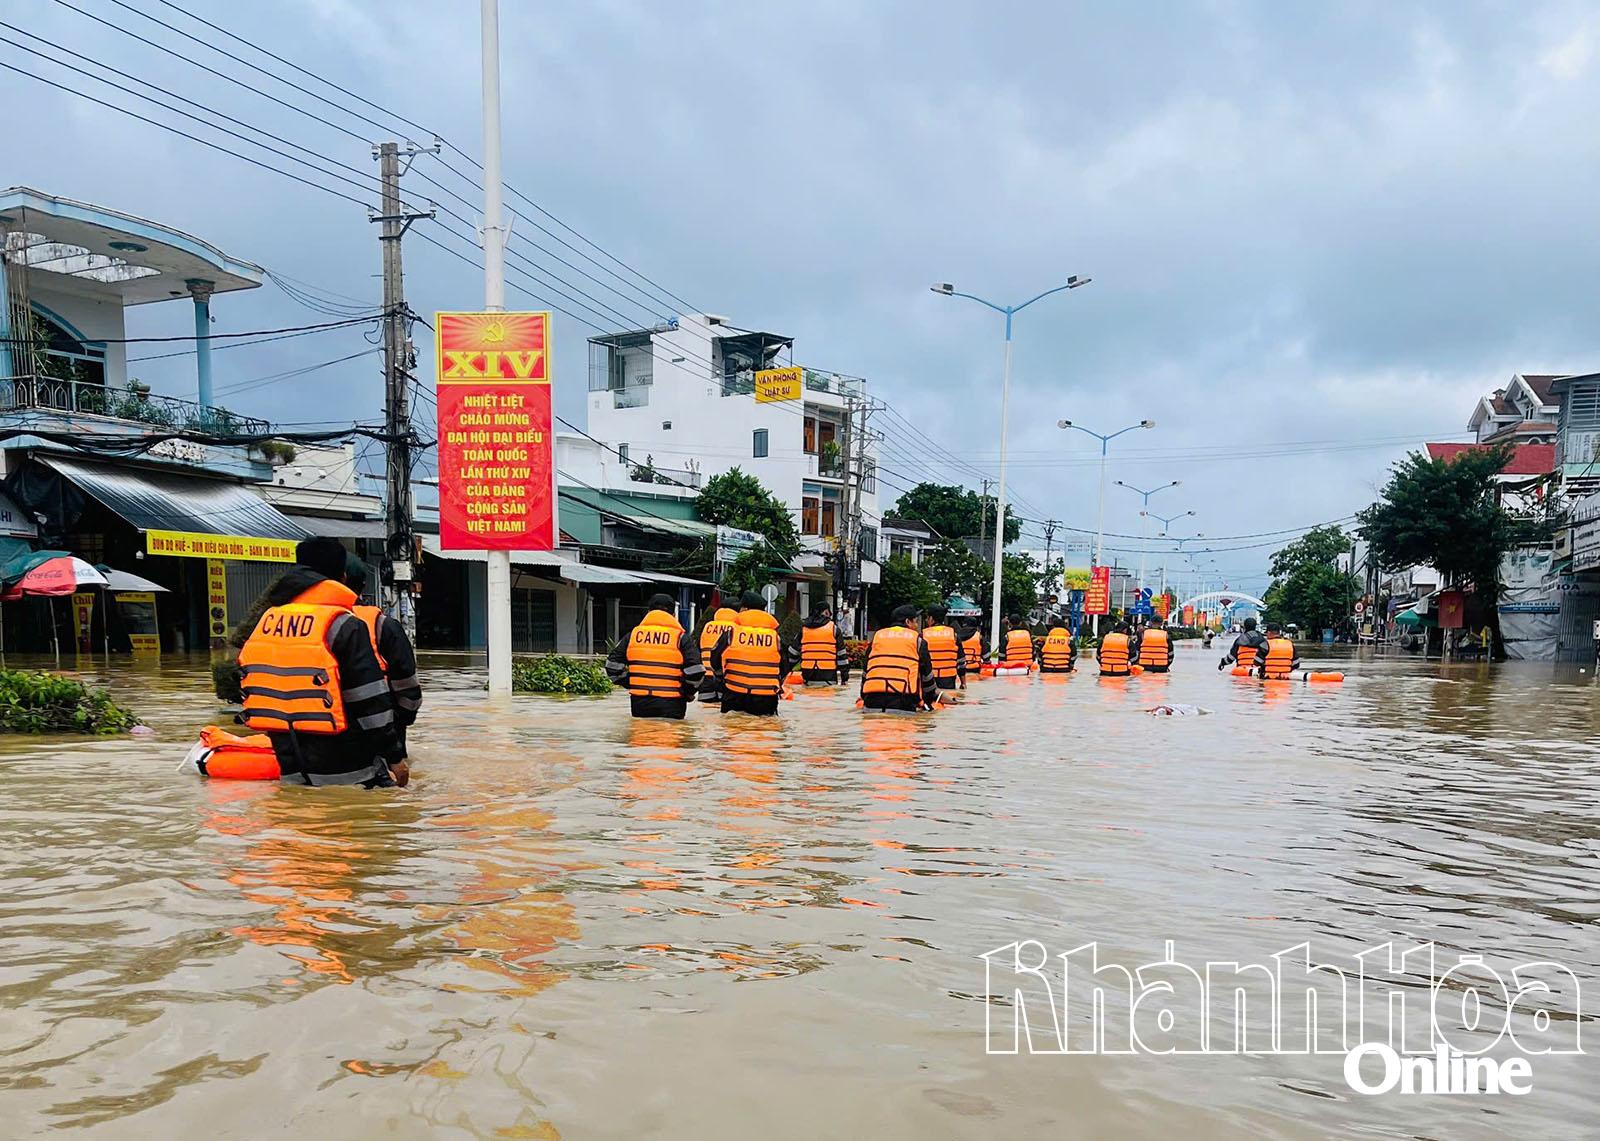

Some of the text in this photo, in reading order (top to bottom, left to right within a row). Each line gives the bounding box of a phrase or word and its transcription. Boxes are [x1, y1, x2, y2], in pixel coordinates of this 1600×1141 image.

[444, 351, 542, 377] XIV
[464, 394, 525, 409] NHIỆT LIỆT
[460, 411, 530, 425] CHÀO MỪNG
[447, 427, 543, 445] ĐẠI HỘI ĐẠI BIỂU
[463, 446, 528, 461] TOÀN QUỐC
[460, 464, 531, 479] LẦN THỨ XIV
[466, 482, 525, 496] CỦA ĐẢNG
[466, 500, 526, 515] CỘNG SẢN
[467, 519, 526, 533] VIỆT NAM!
[262, 614, 315, 638] CAND
[635, 630, 670, 645] CAND
[738, 632, 773, 647] CAND
